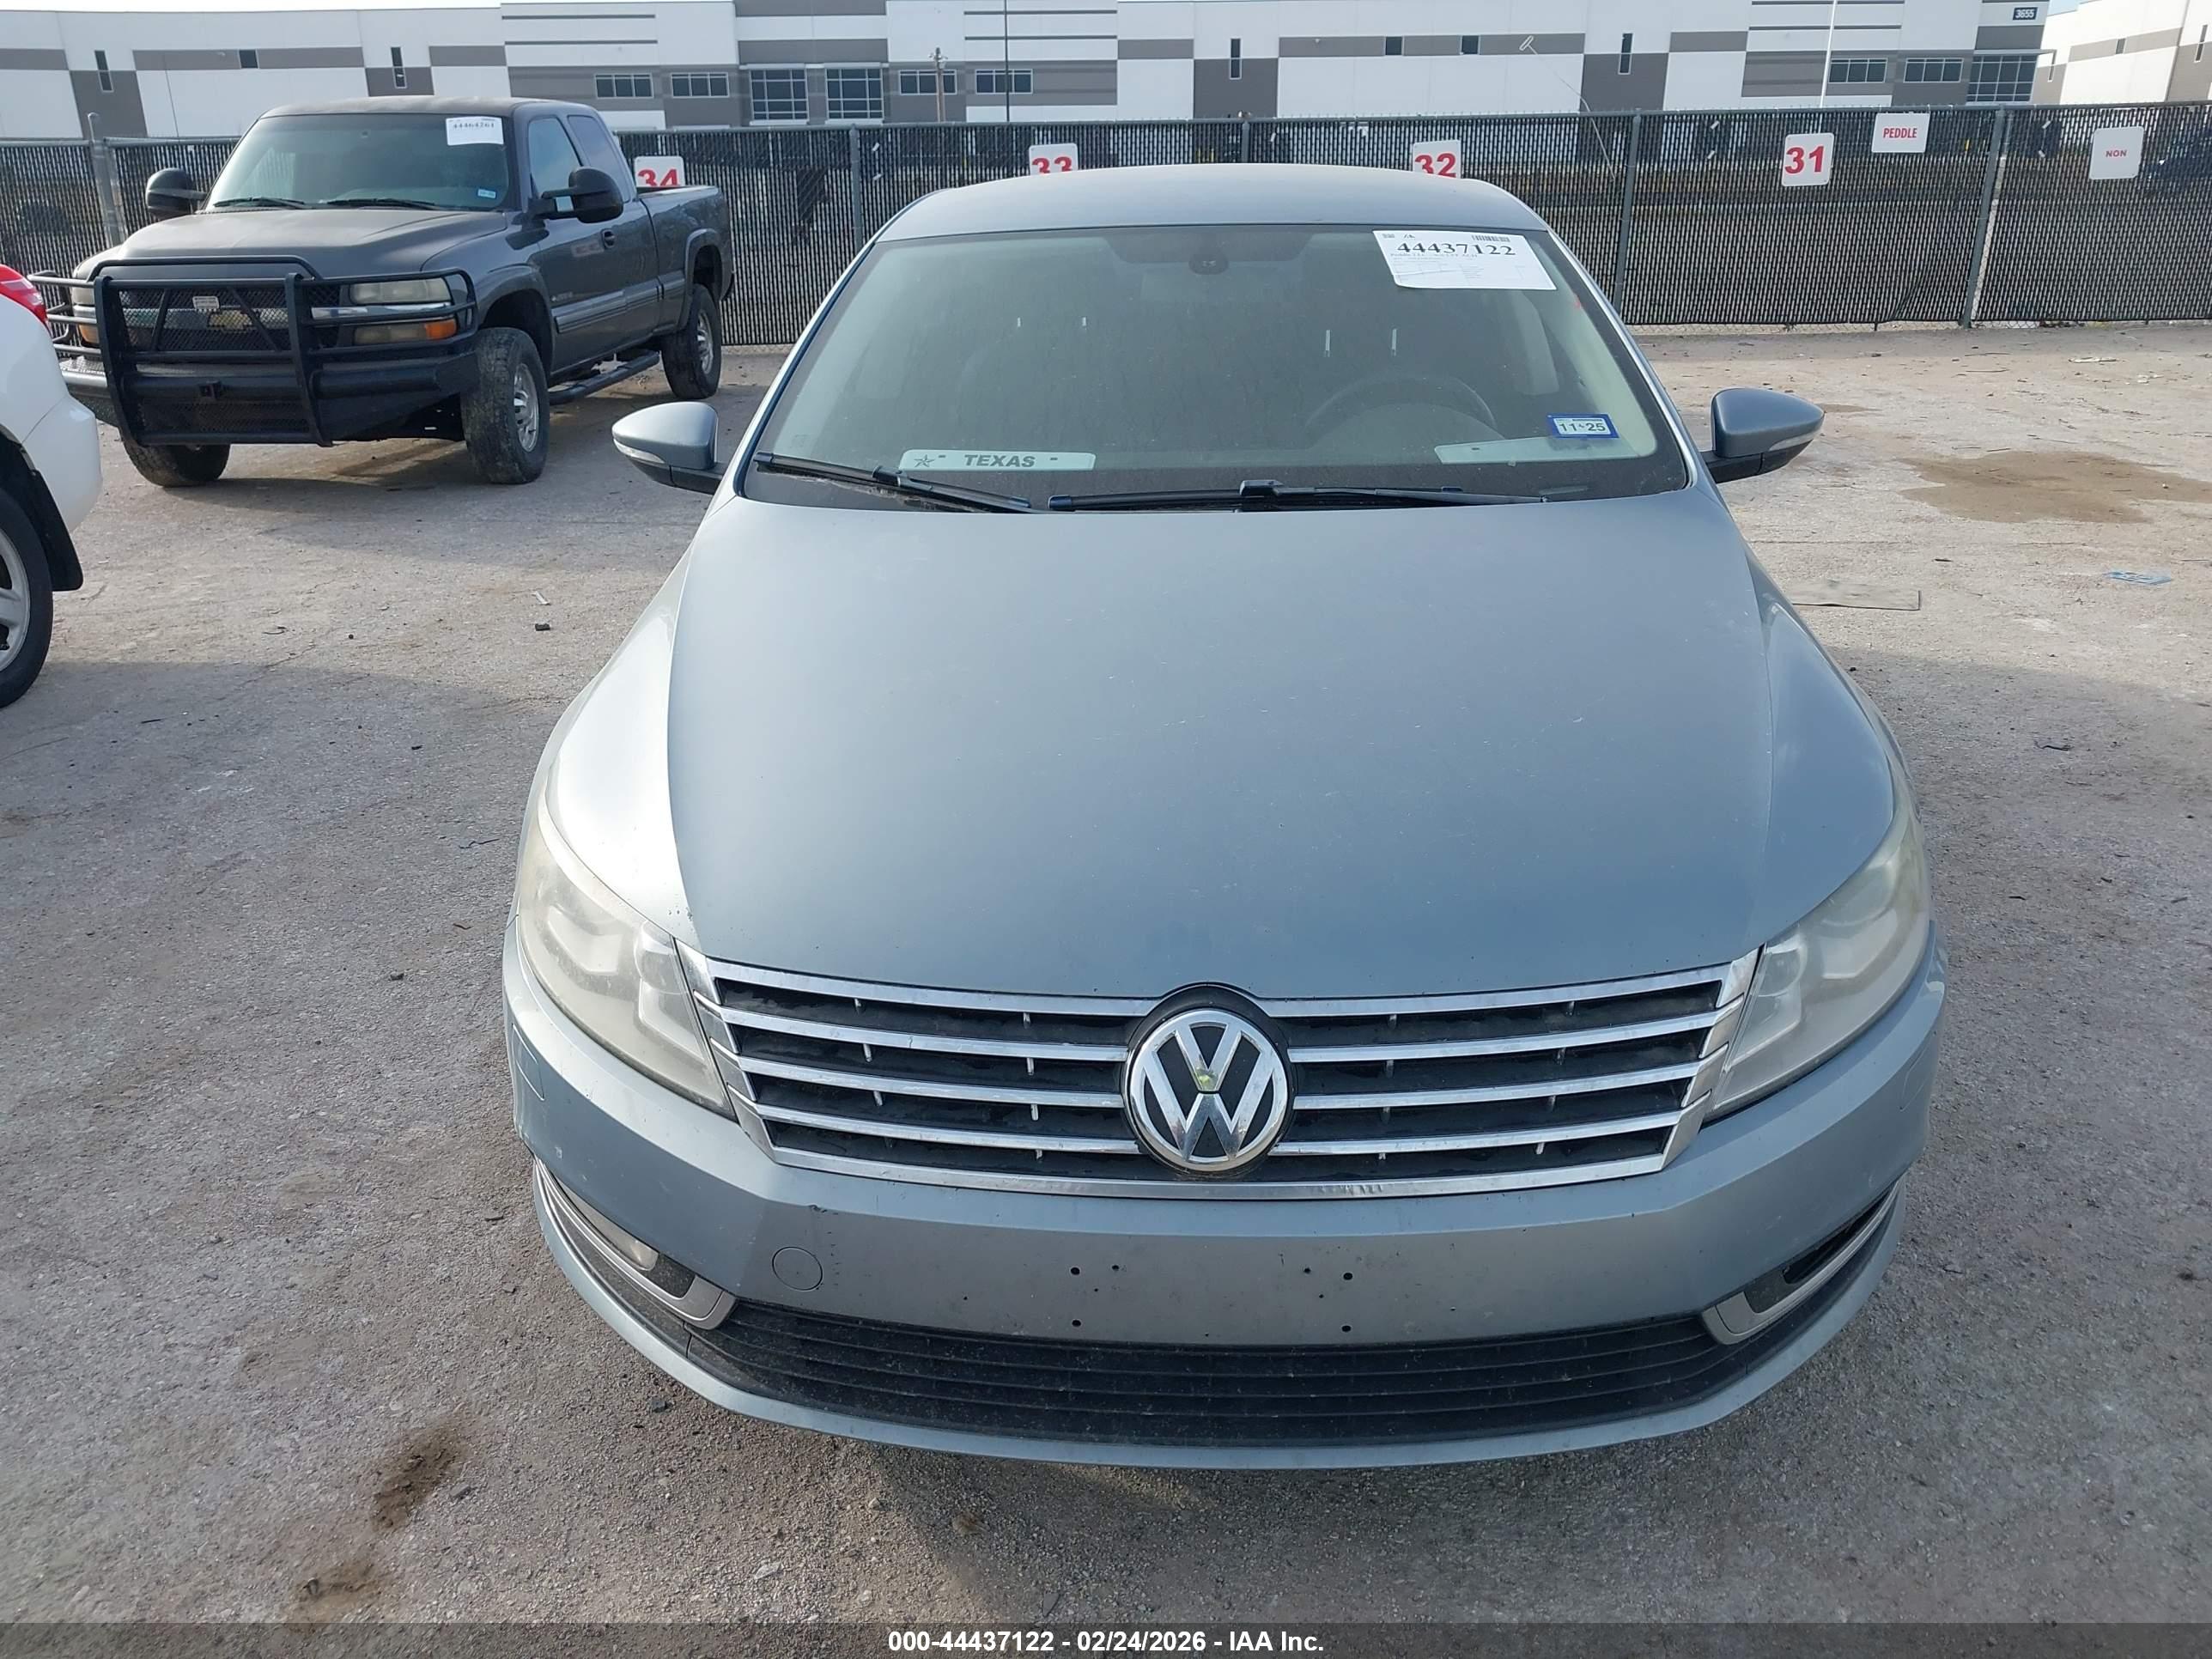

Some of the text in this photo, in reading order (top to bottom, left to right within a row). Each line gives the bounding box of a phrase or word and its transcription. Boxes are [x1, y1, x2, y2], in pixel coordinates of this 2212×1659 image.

[2014, 9, 2035, 19] 3655
[1882, 127, 1918, 138] PEDDLE
[1414, 153, 1457, 179] 32
[1784, 145, 1825, 174] 31
[637, 168, 679, 186] 34
[1396, 241, 1516, 256] 44437122
[1585, 422, 1606, 432] 25
[963, 454, 1036, 468] TEXAS
